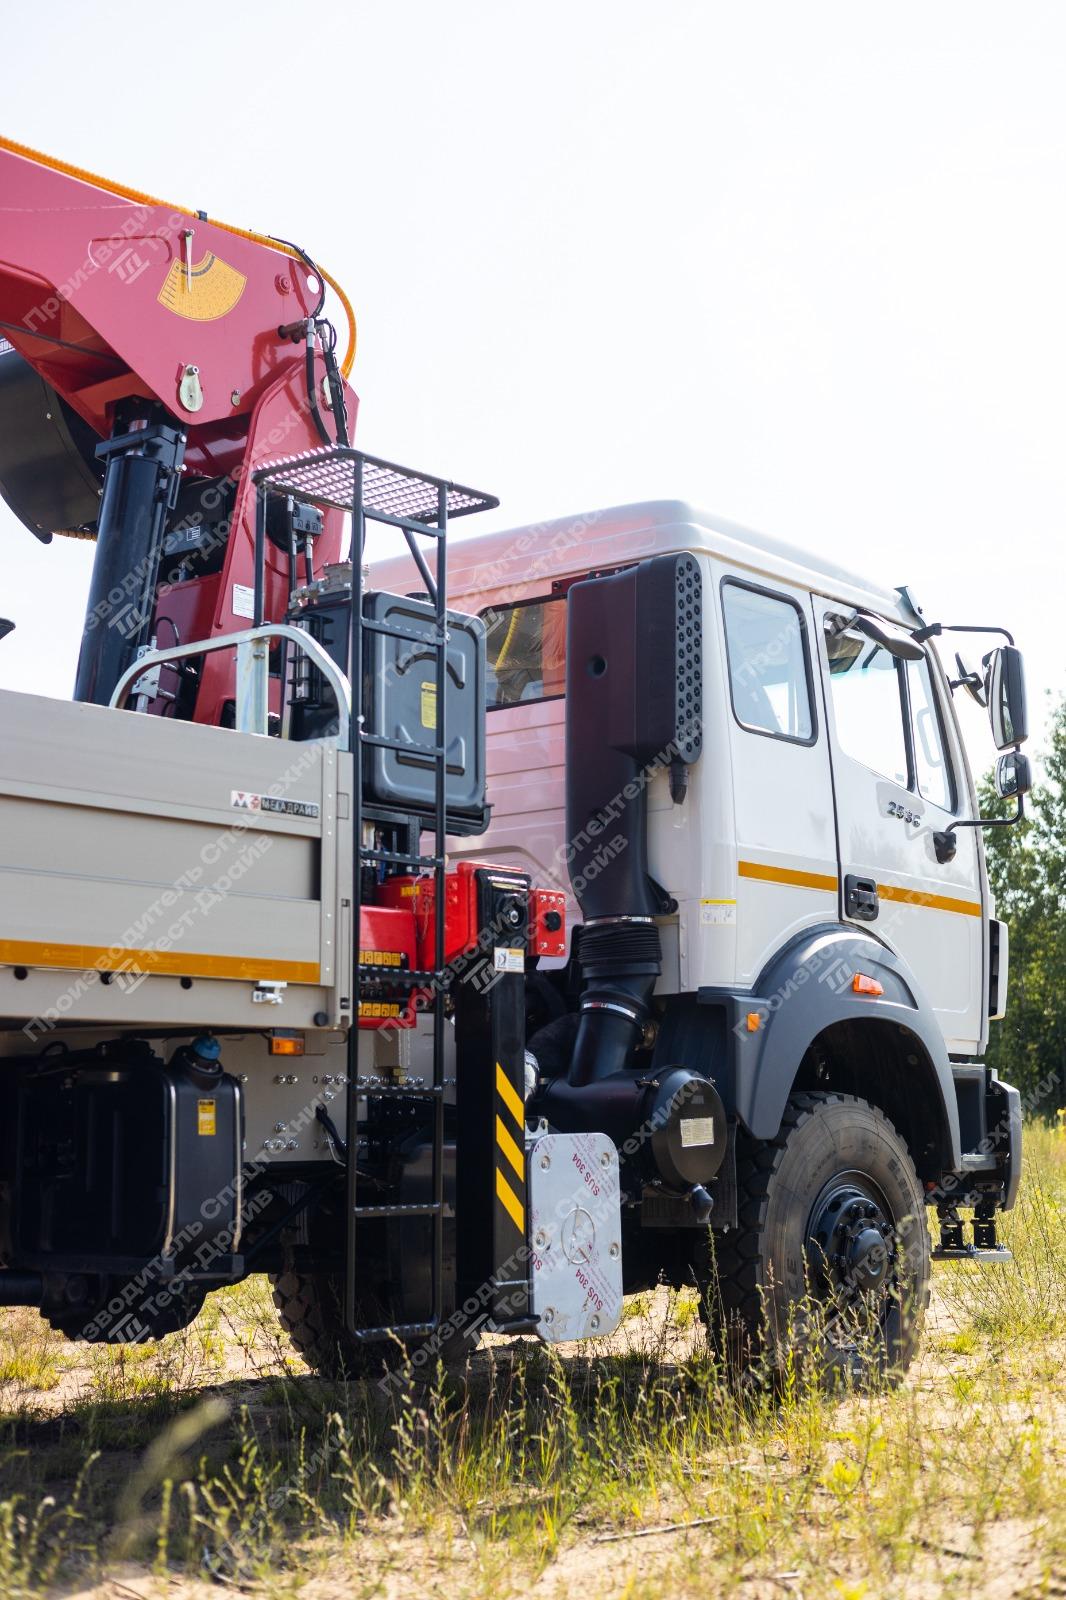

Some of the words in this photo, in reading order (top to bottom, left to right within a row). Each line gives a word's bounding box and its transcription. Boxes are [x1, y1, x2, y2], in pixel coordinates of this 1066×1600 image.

[262, 799, 318, 817] МЕГАДРАЙВ
[572, 1152, 586, 1173] 304
[584, 1170, 600, 1197] SUS
[575, 1268, 589, 1288] 304
